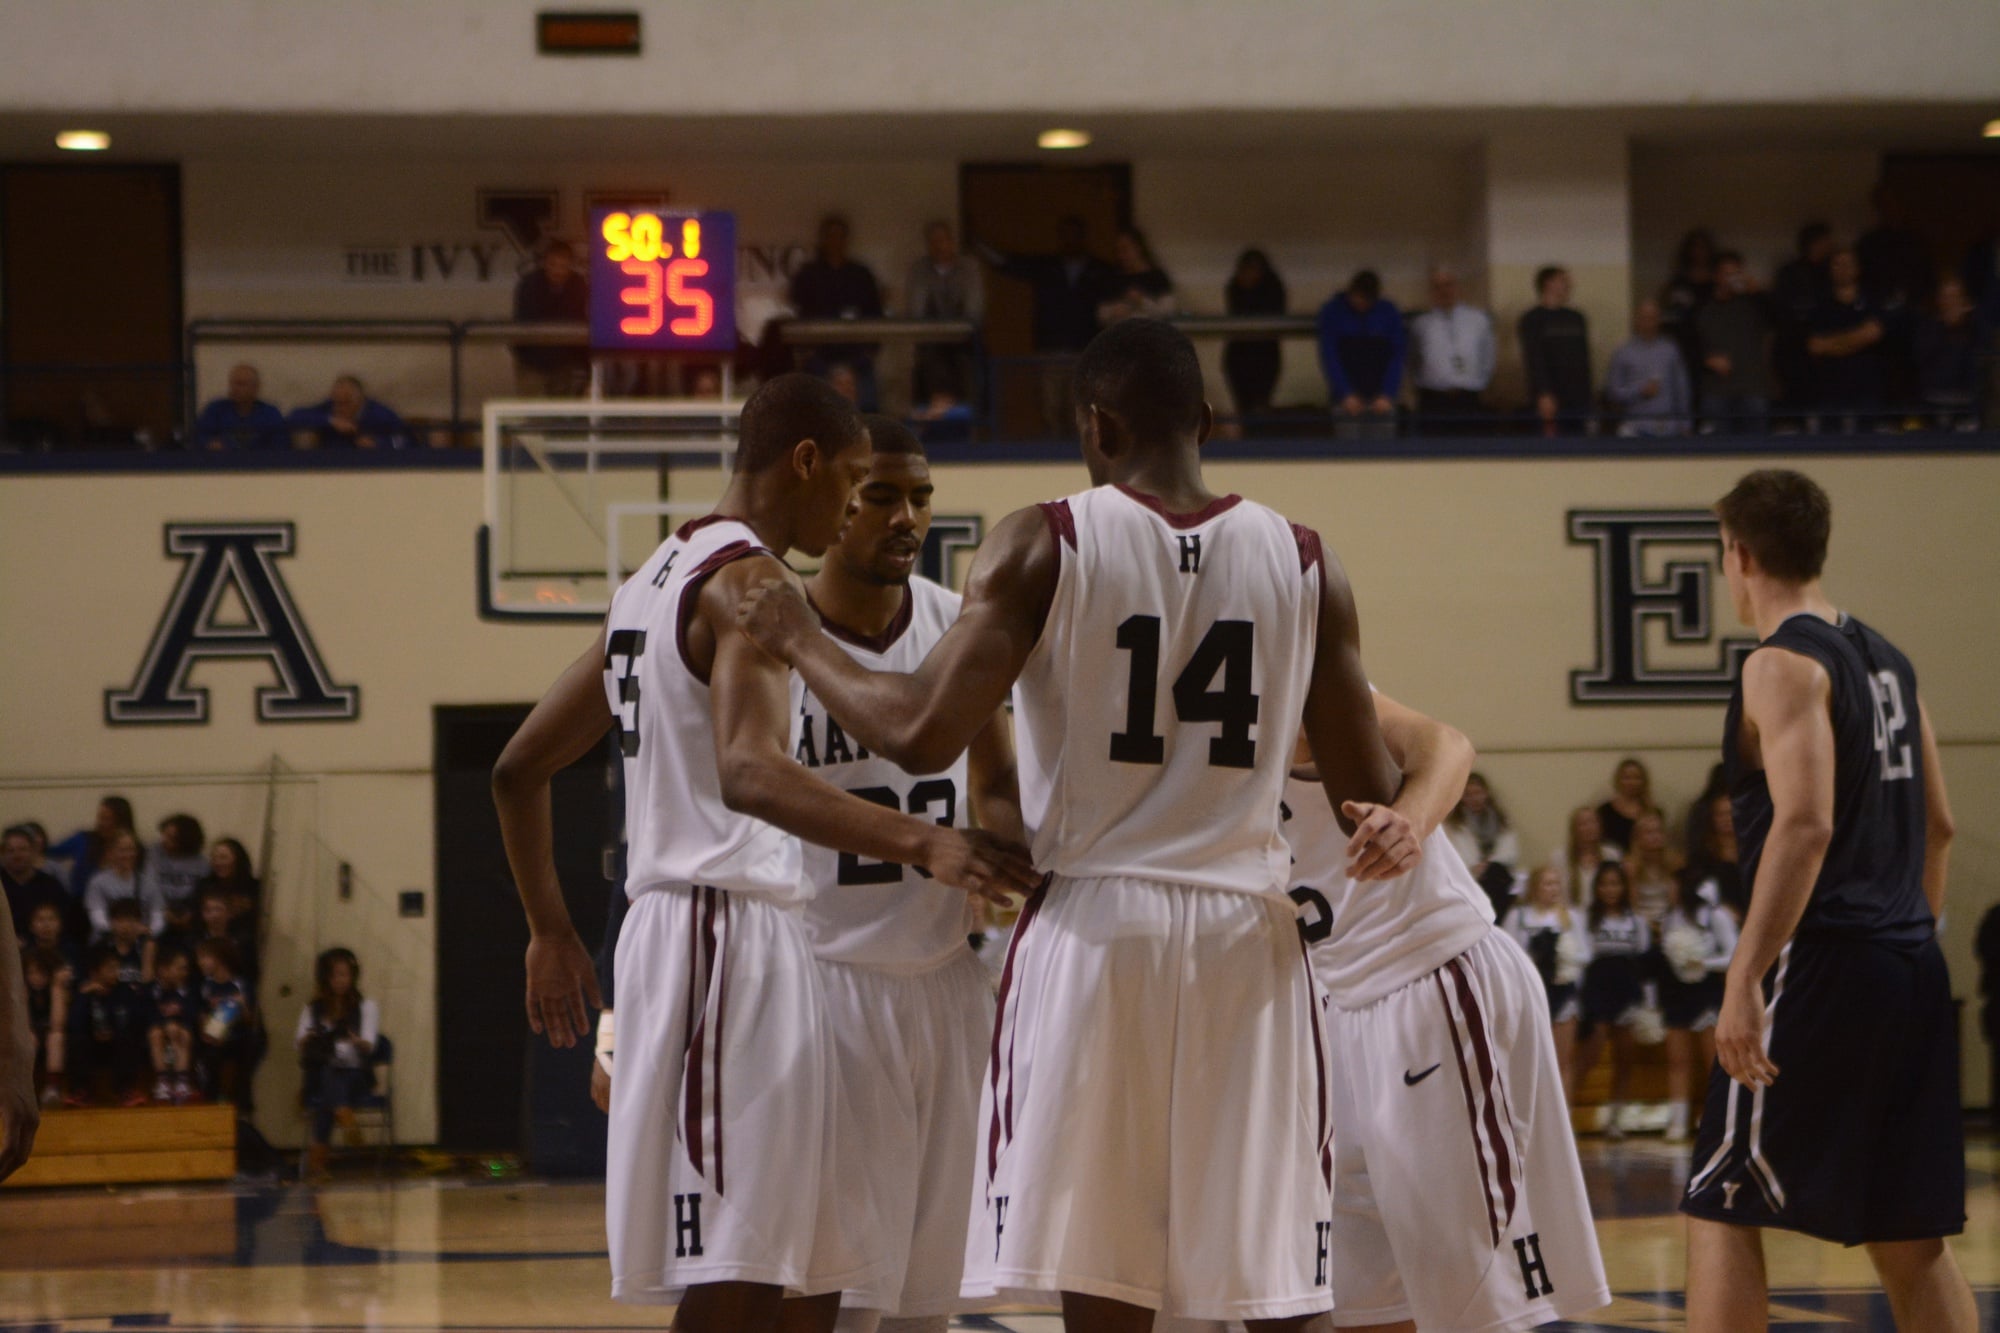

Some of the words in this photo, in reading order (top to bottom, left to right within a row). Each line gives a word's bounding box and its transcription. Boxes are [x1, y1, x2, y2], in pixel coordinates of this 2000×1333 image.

[409, 243, 499, 281] IVY
[620, 259, 714, 336] 35
[651, 550, 680, 590] H
[1176, 534, 1201, 574] H
[1110, 614, 1260, 769] 14
[1722, 1181, 1741, 1210] Y
[673, 1192, 704, 1259] H
[1512, 1233, 1555, 1300] H
